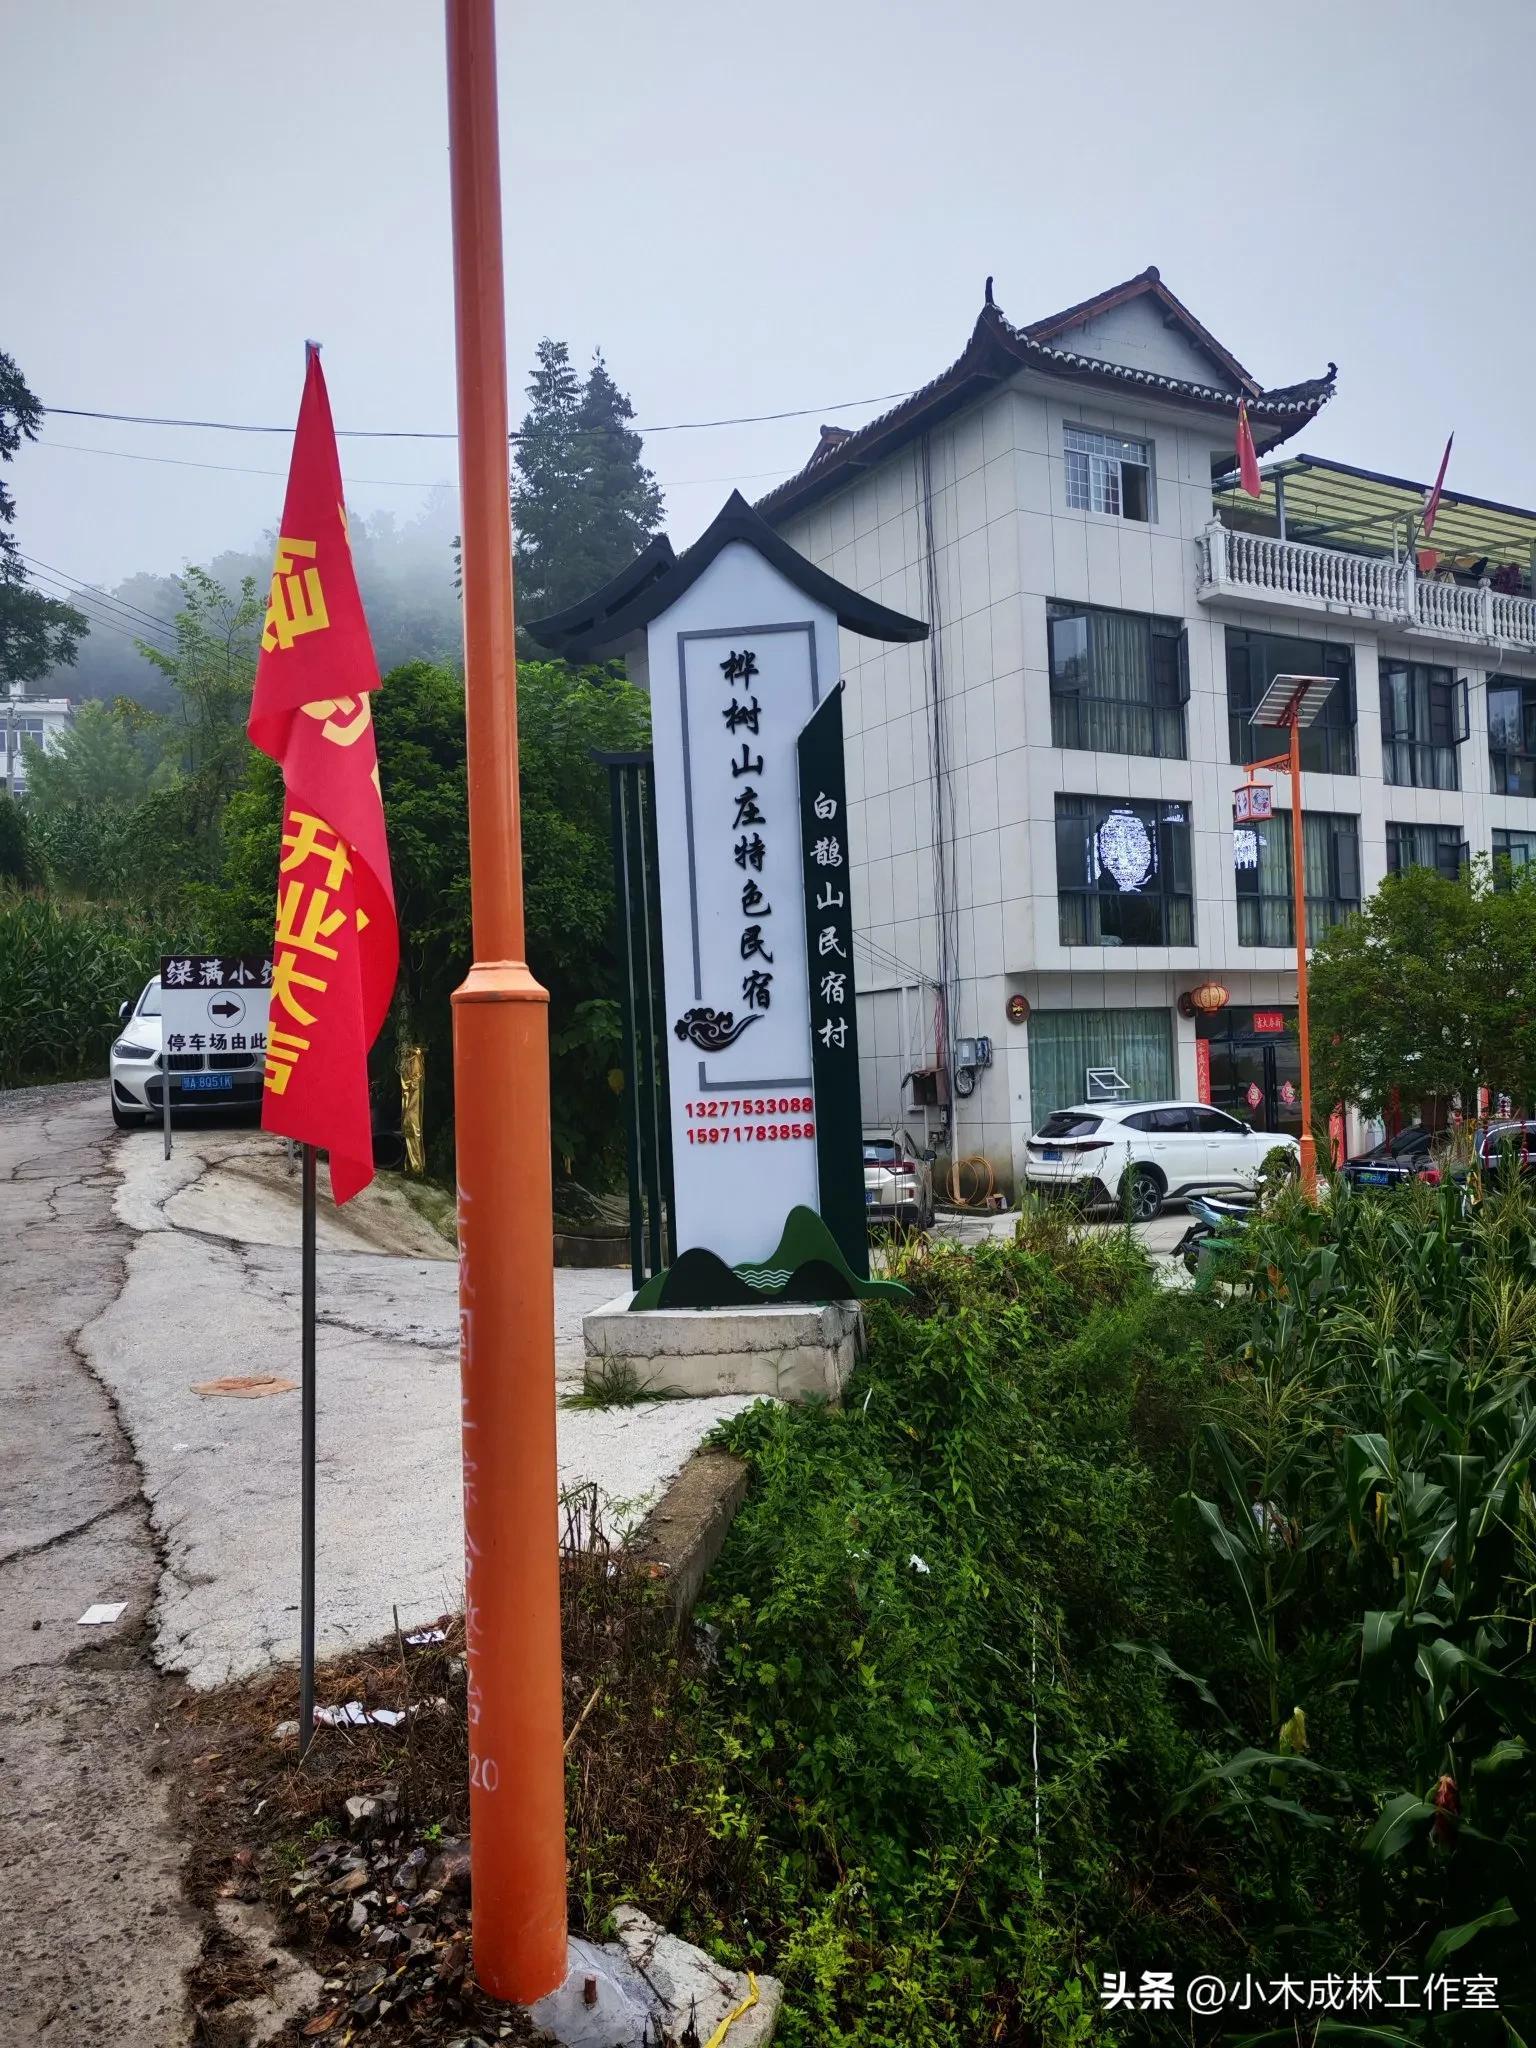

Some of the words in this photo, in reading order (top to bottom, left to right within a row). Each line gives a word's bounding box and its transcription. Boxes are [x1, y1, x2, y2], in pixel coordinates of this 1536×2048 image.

[719, 649, 774, 1010] 桦树山庄特色民宿
[809, 791, 849, 1049] 白鹊山民宿村
[166, 1032, 267, 1052] 停车场由此
[685, 1096, 814, 1119] 13277533088
[686, 1122, 816, 1145] 15971783858
